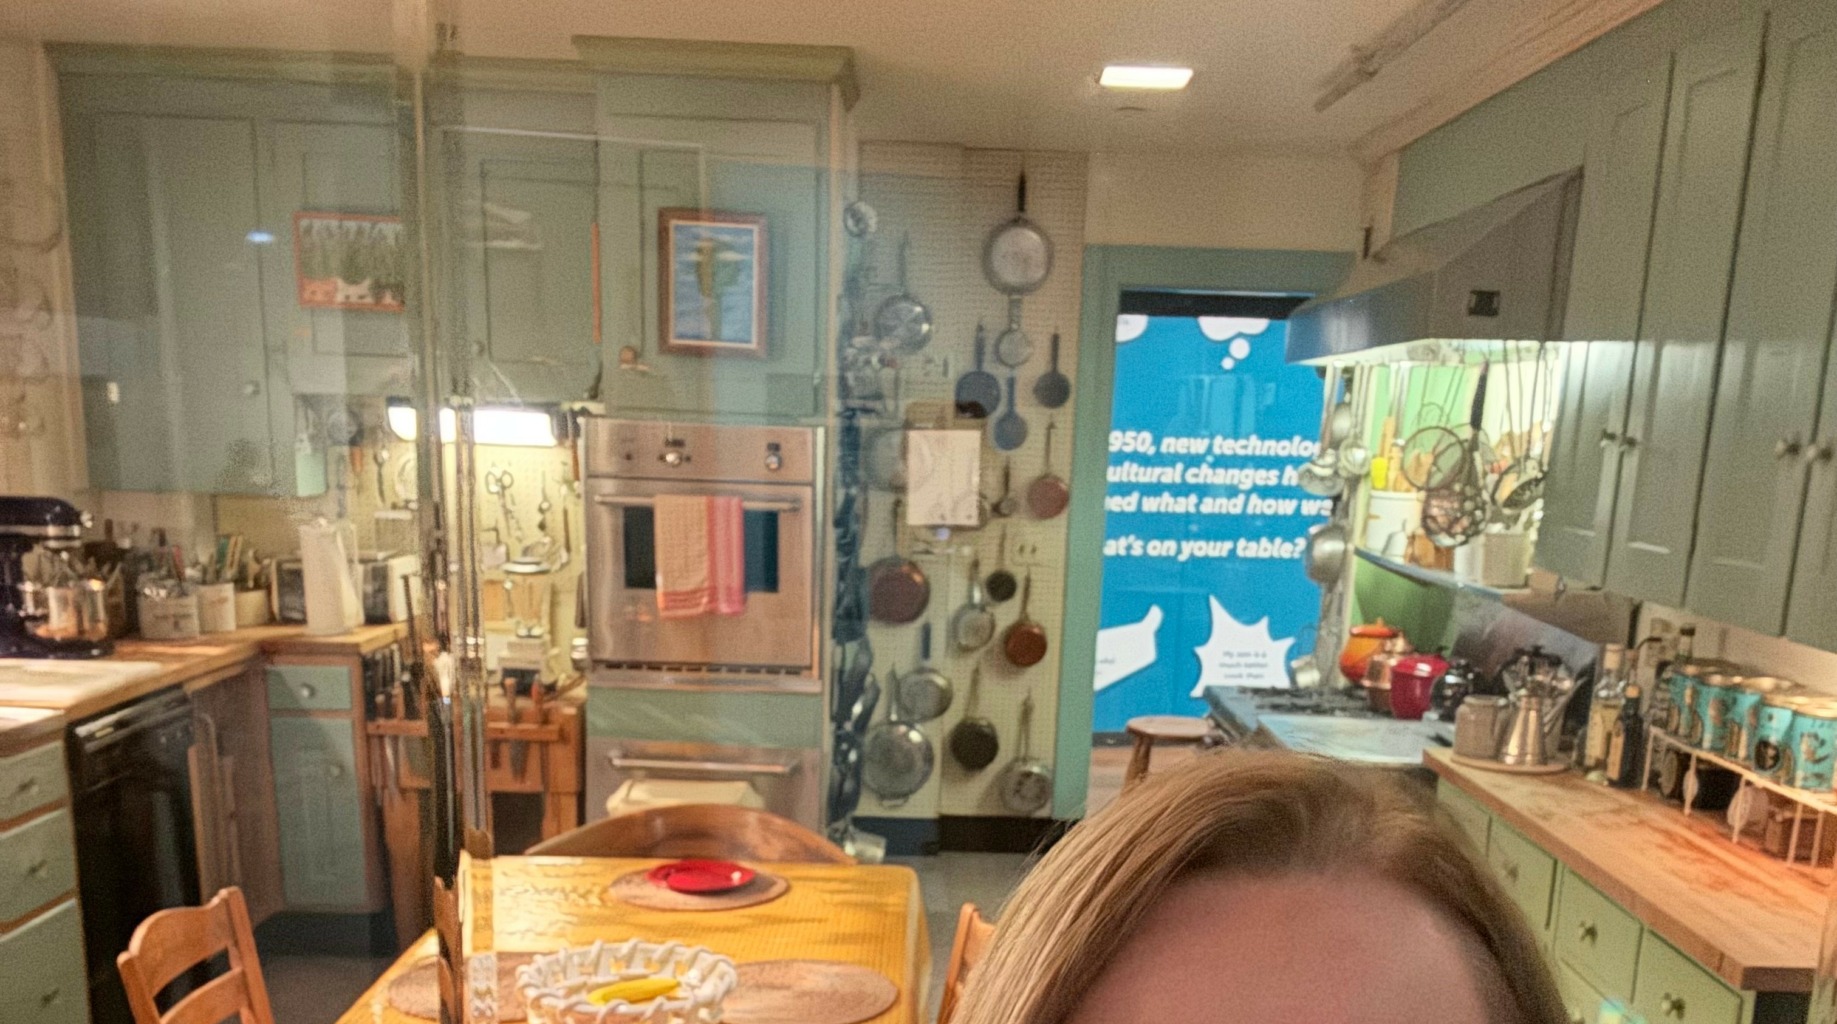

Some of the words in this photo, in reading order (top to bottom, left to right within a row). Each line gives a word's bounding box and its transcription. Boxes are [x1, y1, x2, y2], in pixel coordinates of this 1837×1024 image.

[1160, 437, 1210, 454] new
[1106, 461, 1184, 483] ultural
[1185, 463, 1280, 490] changes
[1142, 491, 1198, 513] what
[1200, 493, 1245, 514] and
[1246, 494, 1299, 515] how
[1103, 535, 1144, 556] at's
[1146, 540, 1178, 556] on
[1178, 540, 1234, 561] your
[1236, 537, 1306, 559] table?
